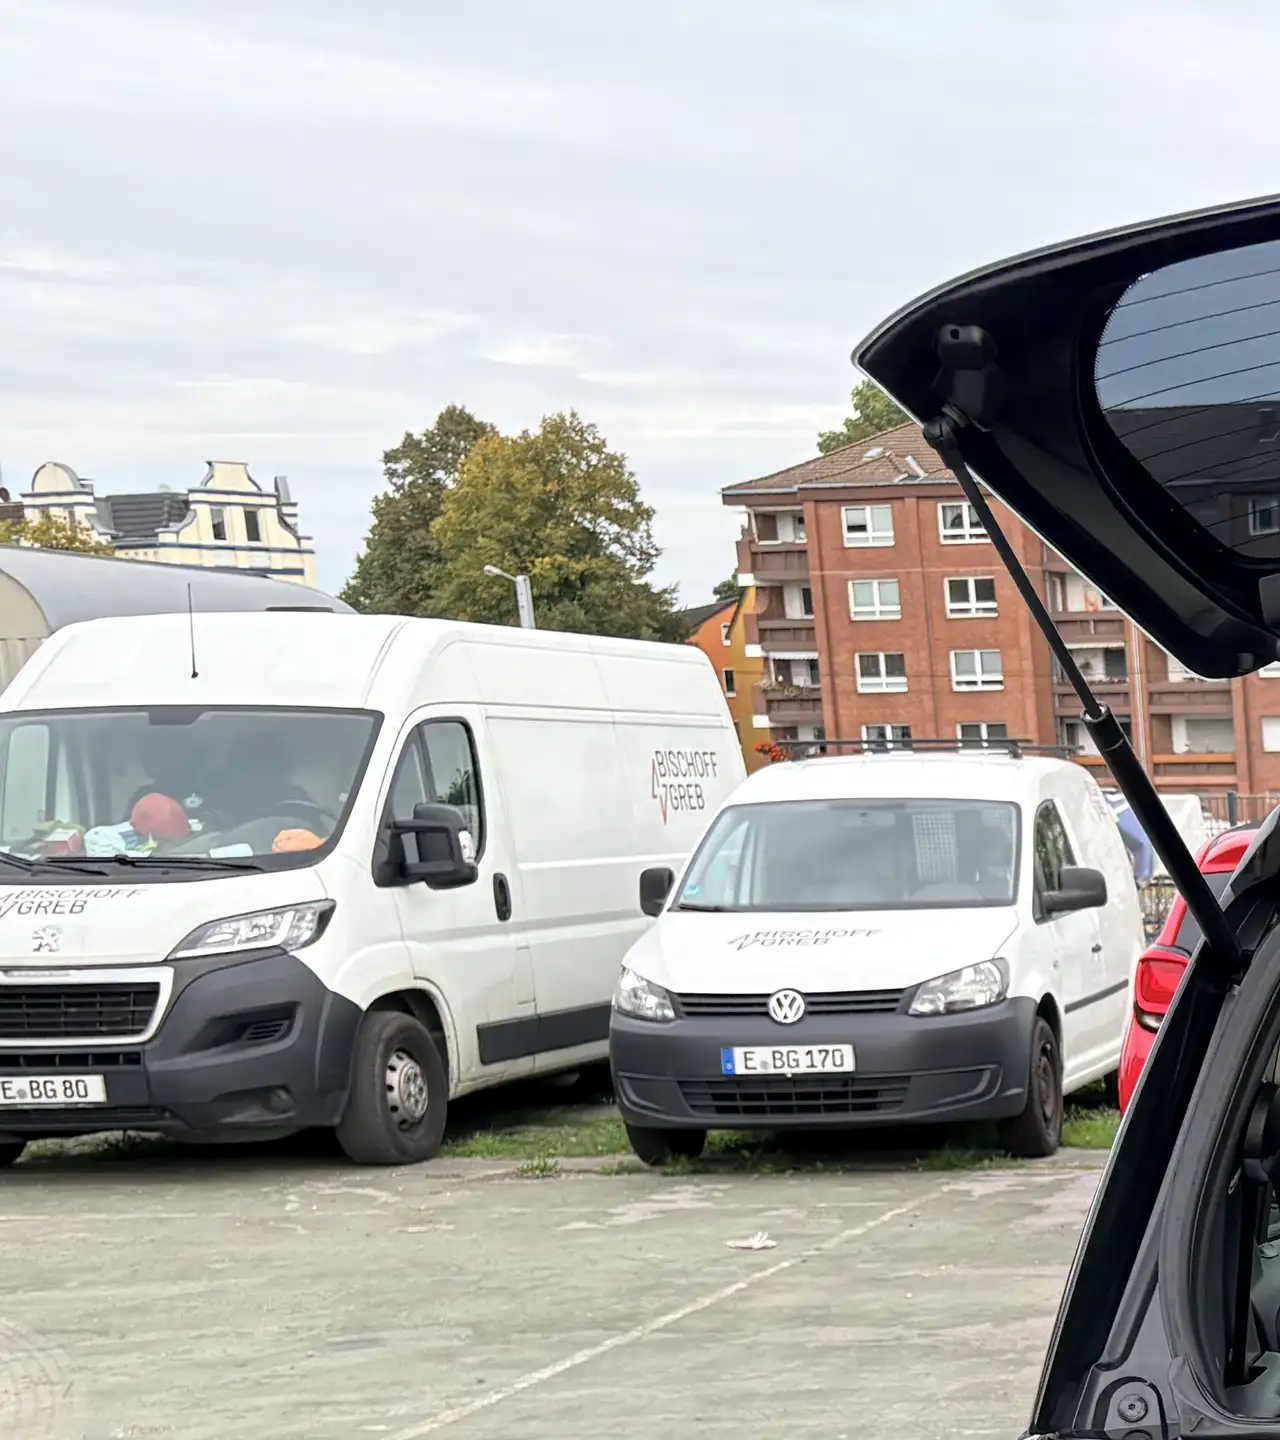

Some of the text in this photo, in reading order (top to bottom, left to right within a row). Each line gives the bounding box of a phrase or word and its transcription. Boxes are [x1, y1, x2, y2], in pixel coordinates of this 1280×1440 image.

[655, 750, 717, 778] BISCHOFF
[669, 783, 705, 811] GREB
[15, 888, 148, 900] BISCHOFF
[17, 899, 88, 915] GREB
[743, 1048, 845, 1070] E BG 170
[1, 1079, 88, 1100] E BG 80
